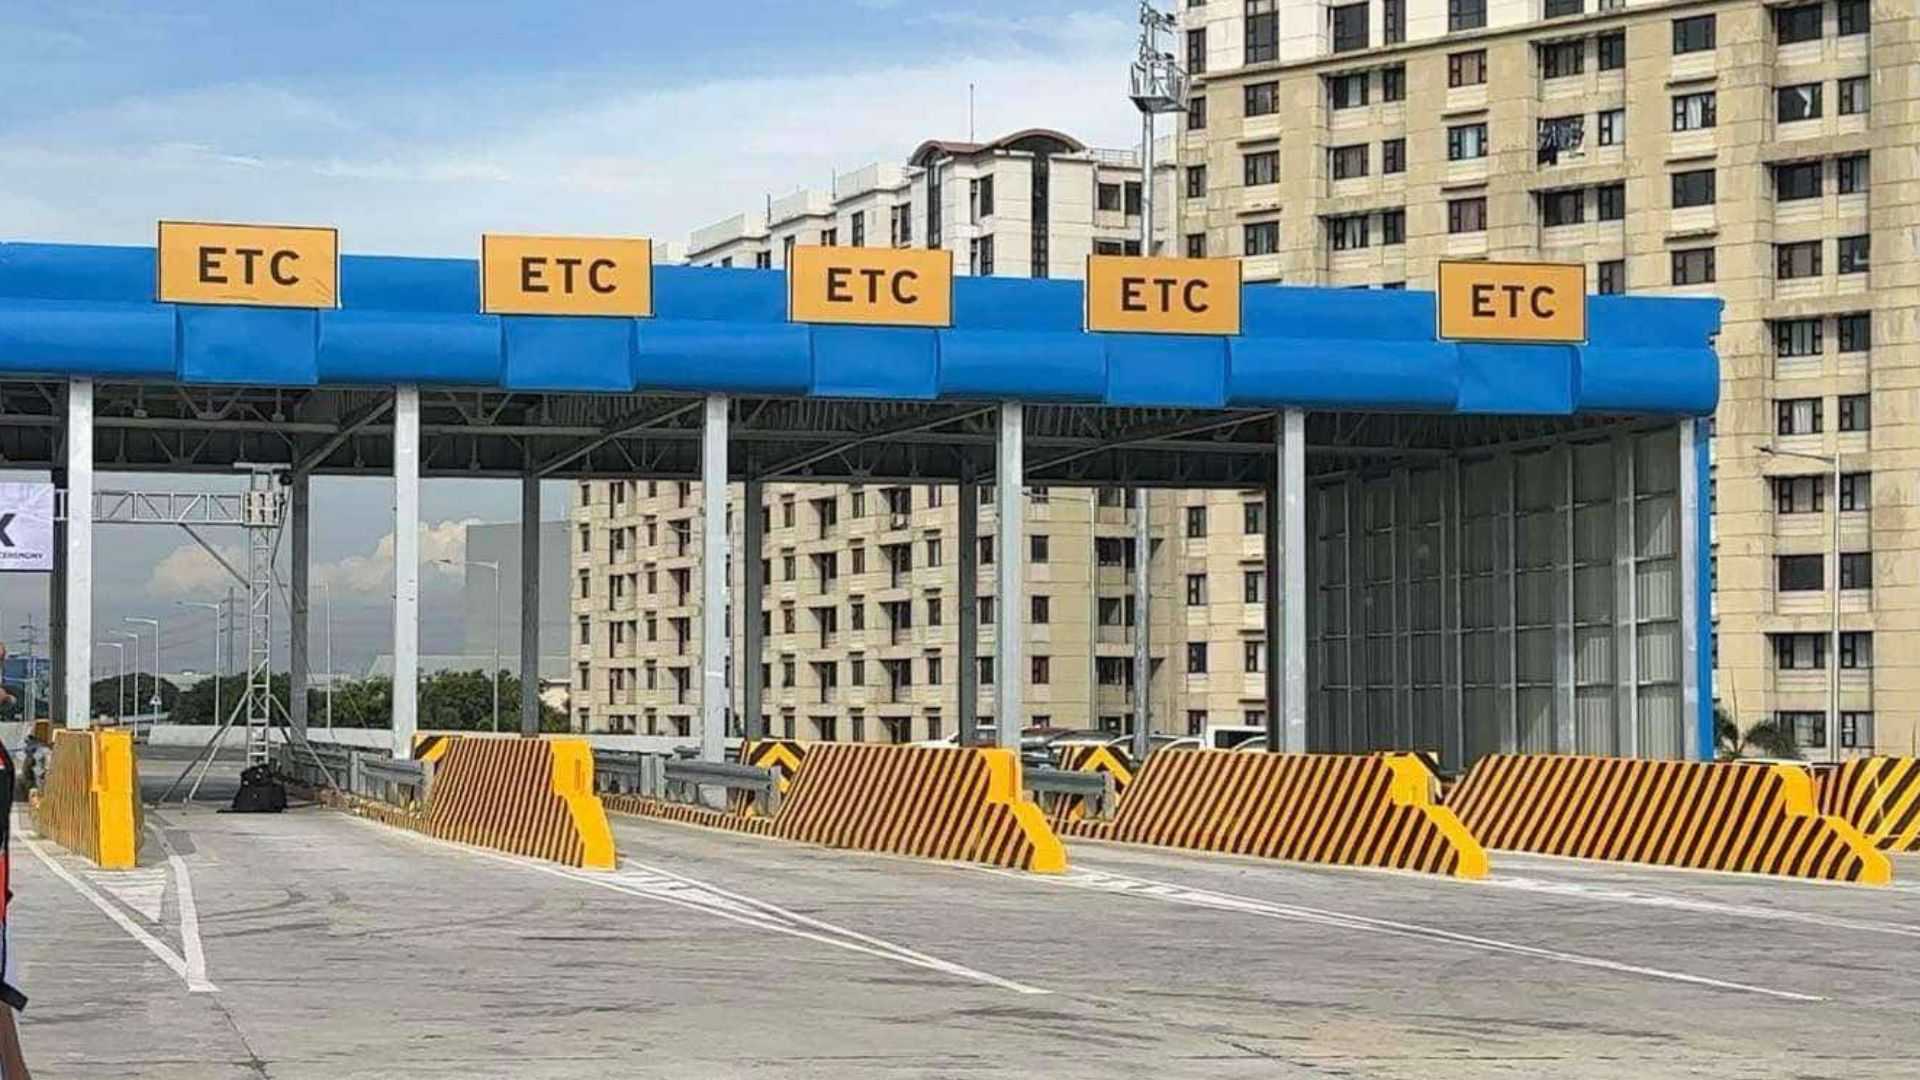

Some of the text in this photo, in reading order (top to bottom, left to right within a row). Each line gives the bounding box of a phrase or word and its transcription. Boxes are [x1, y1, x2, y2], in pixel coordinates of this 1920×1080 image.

[199, 247, 299, 286] ETC
[522, 257, 616, 293] ETC
[827, 267, 917, 304] ETC
[1122, 277, 1208, 313] ETC
[1472, 284, 1554, 318] ETC
